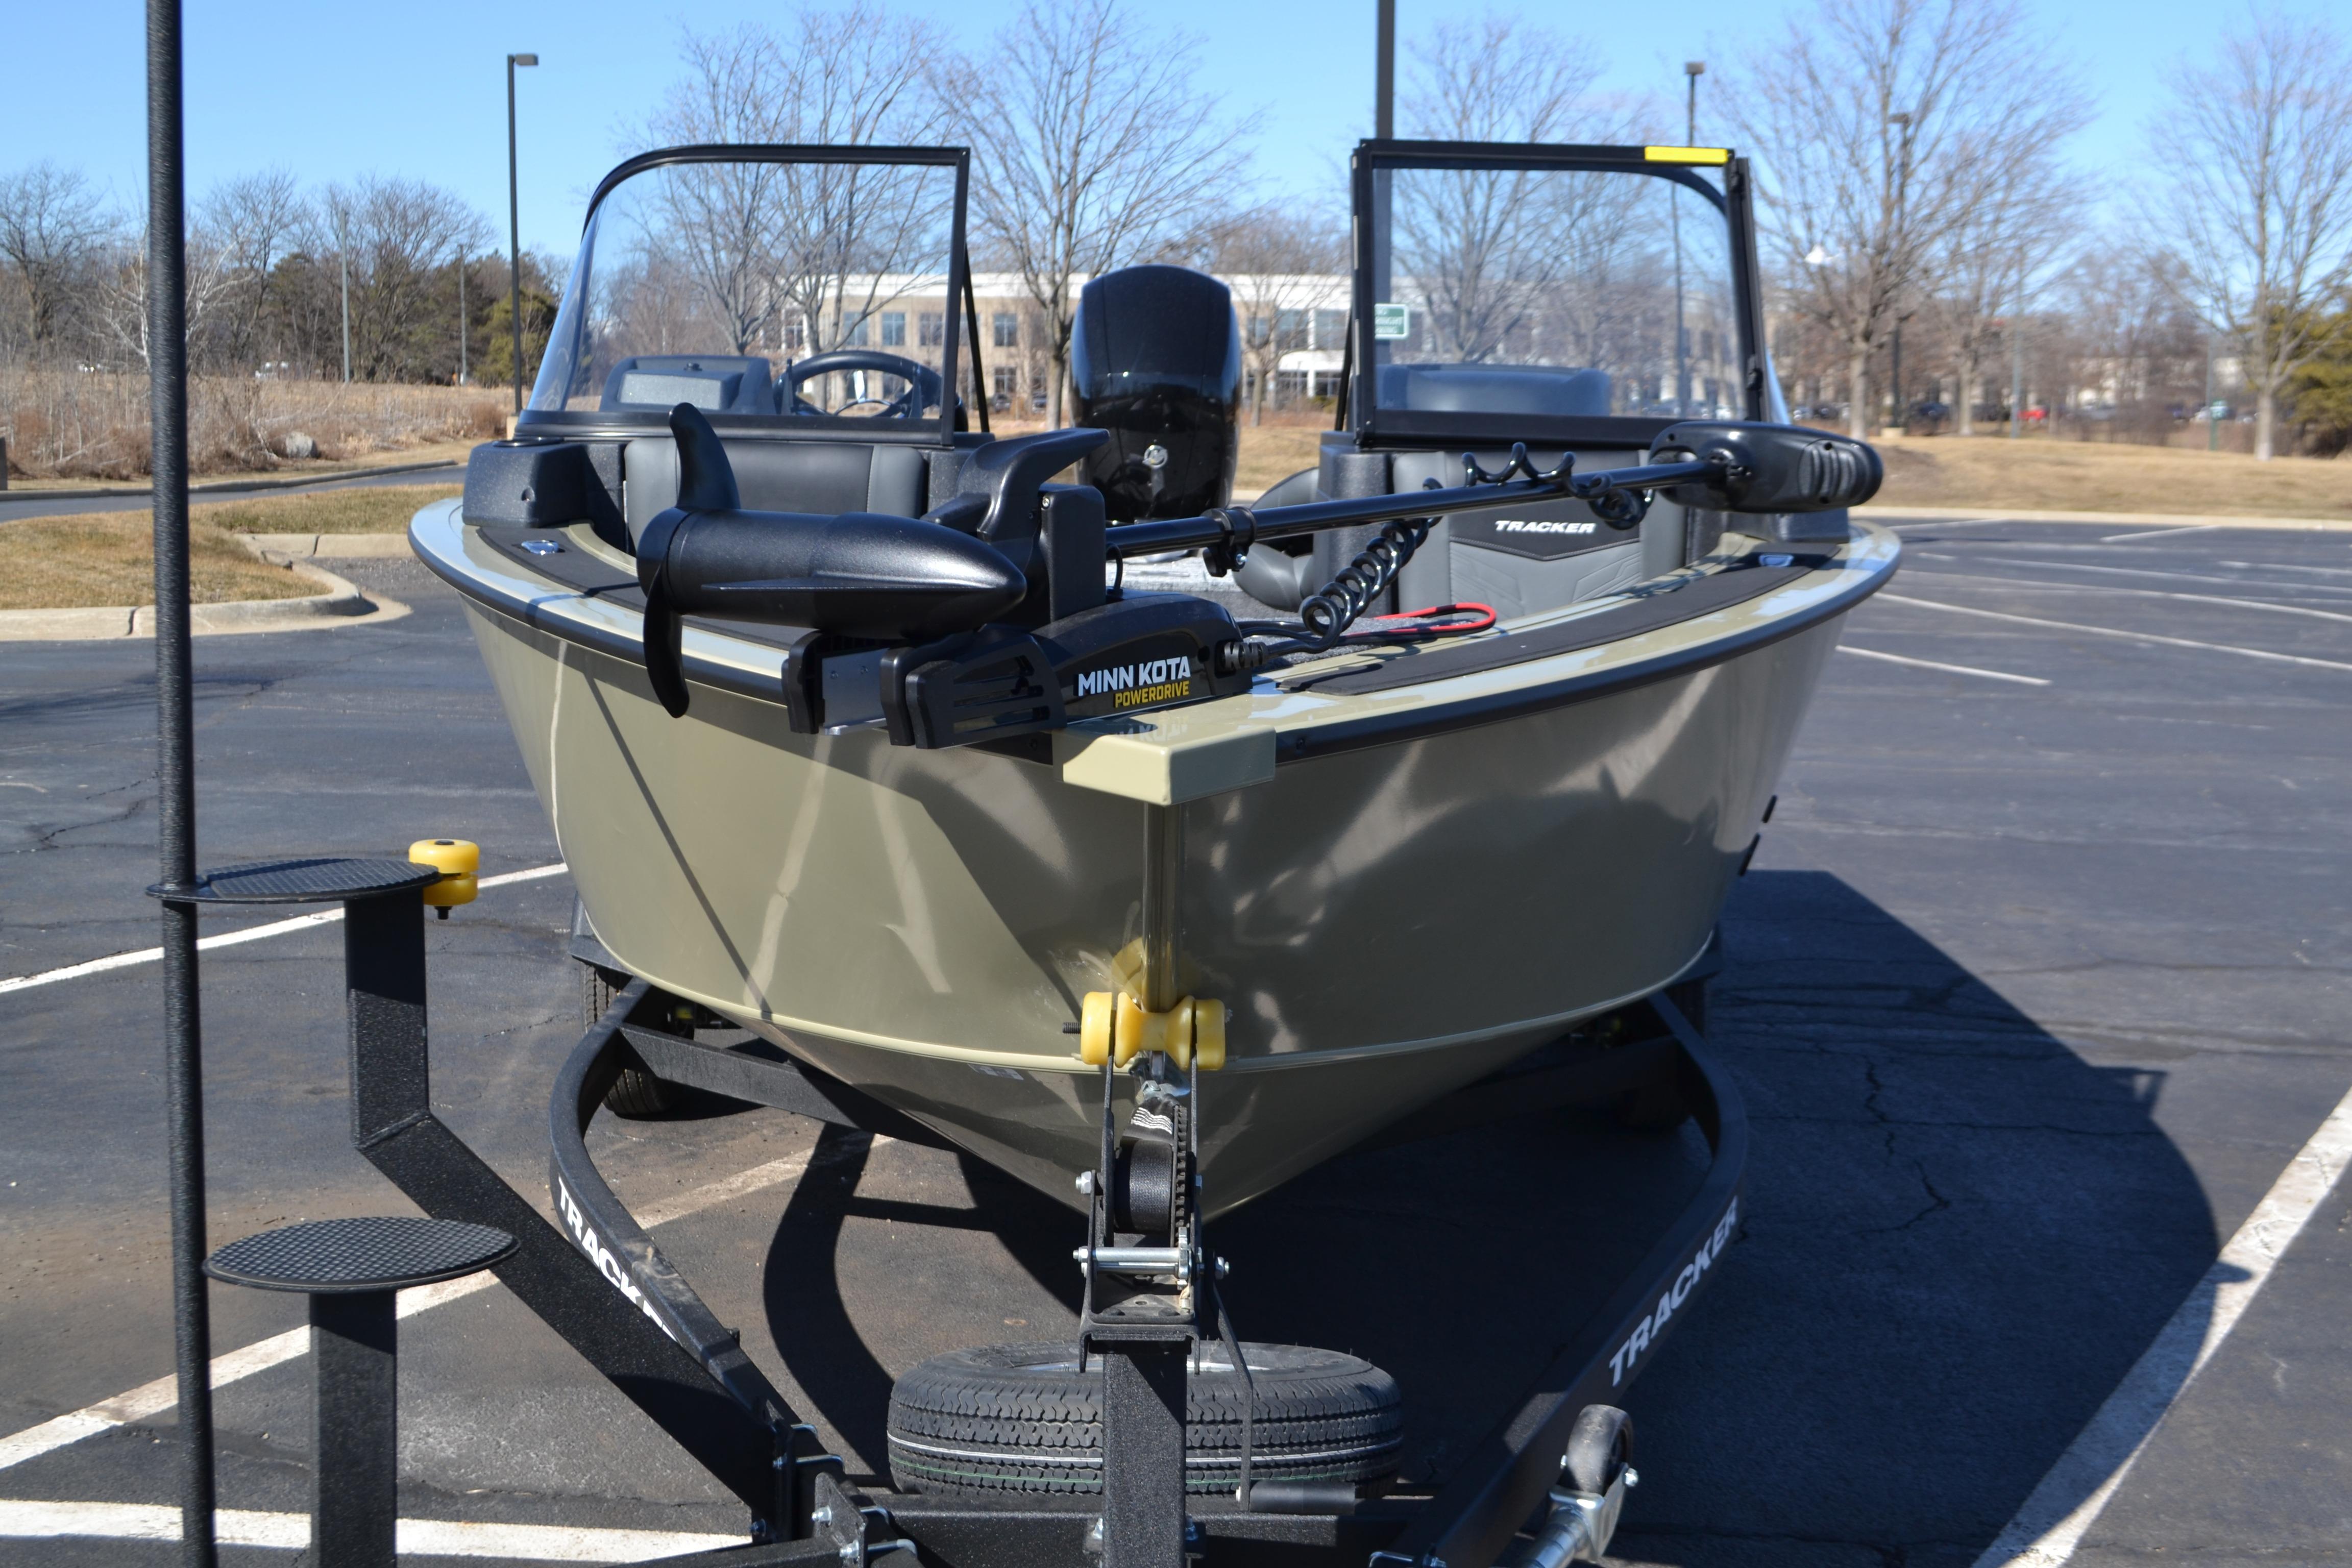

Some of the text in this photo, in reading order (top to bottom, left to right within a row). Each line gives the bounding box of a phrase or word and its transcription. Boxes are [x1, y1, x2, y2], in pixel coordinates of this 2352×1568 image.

[1495, 520, 1596, 534] TRACKER
[1078, 656, 1191, 697] MINN KOTA
[1115, 680, 1190, 708] POWERDRIVE
[558, 1175, 678, 1342] TRACK
[1609, 1195, 1737, 1387] TRACKER
